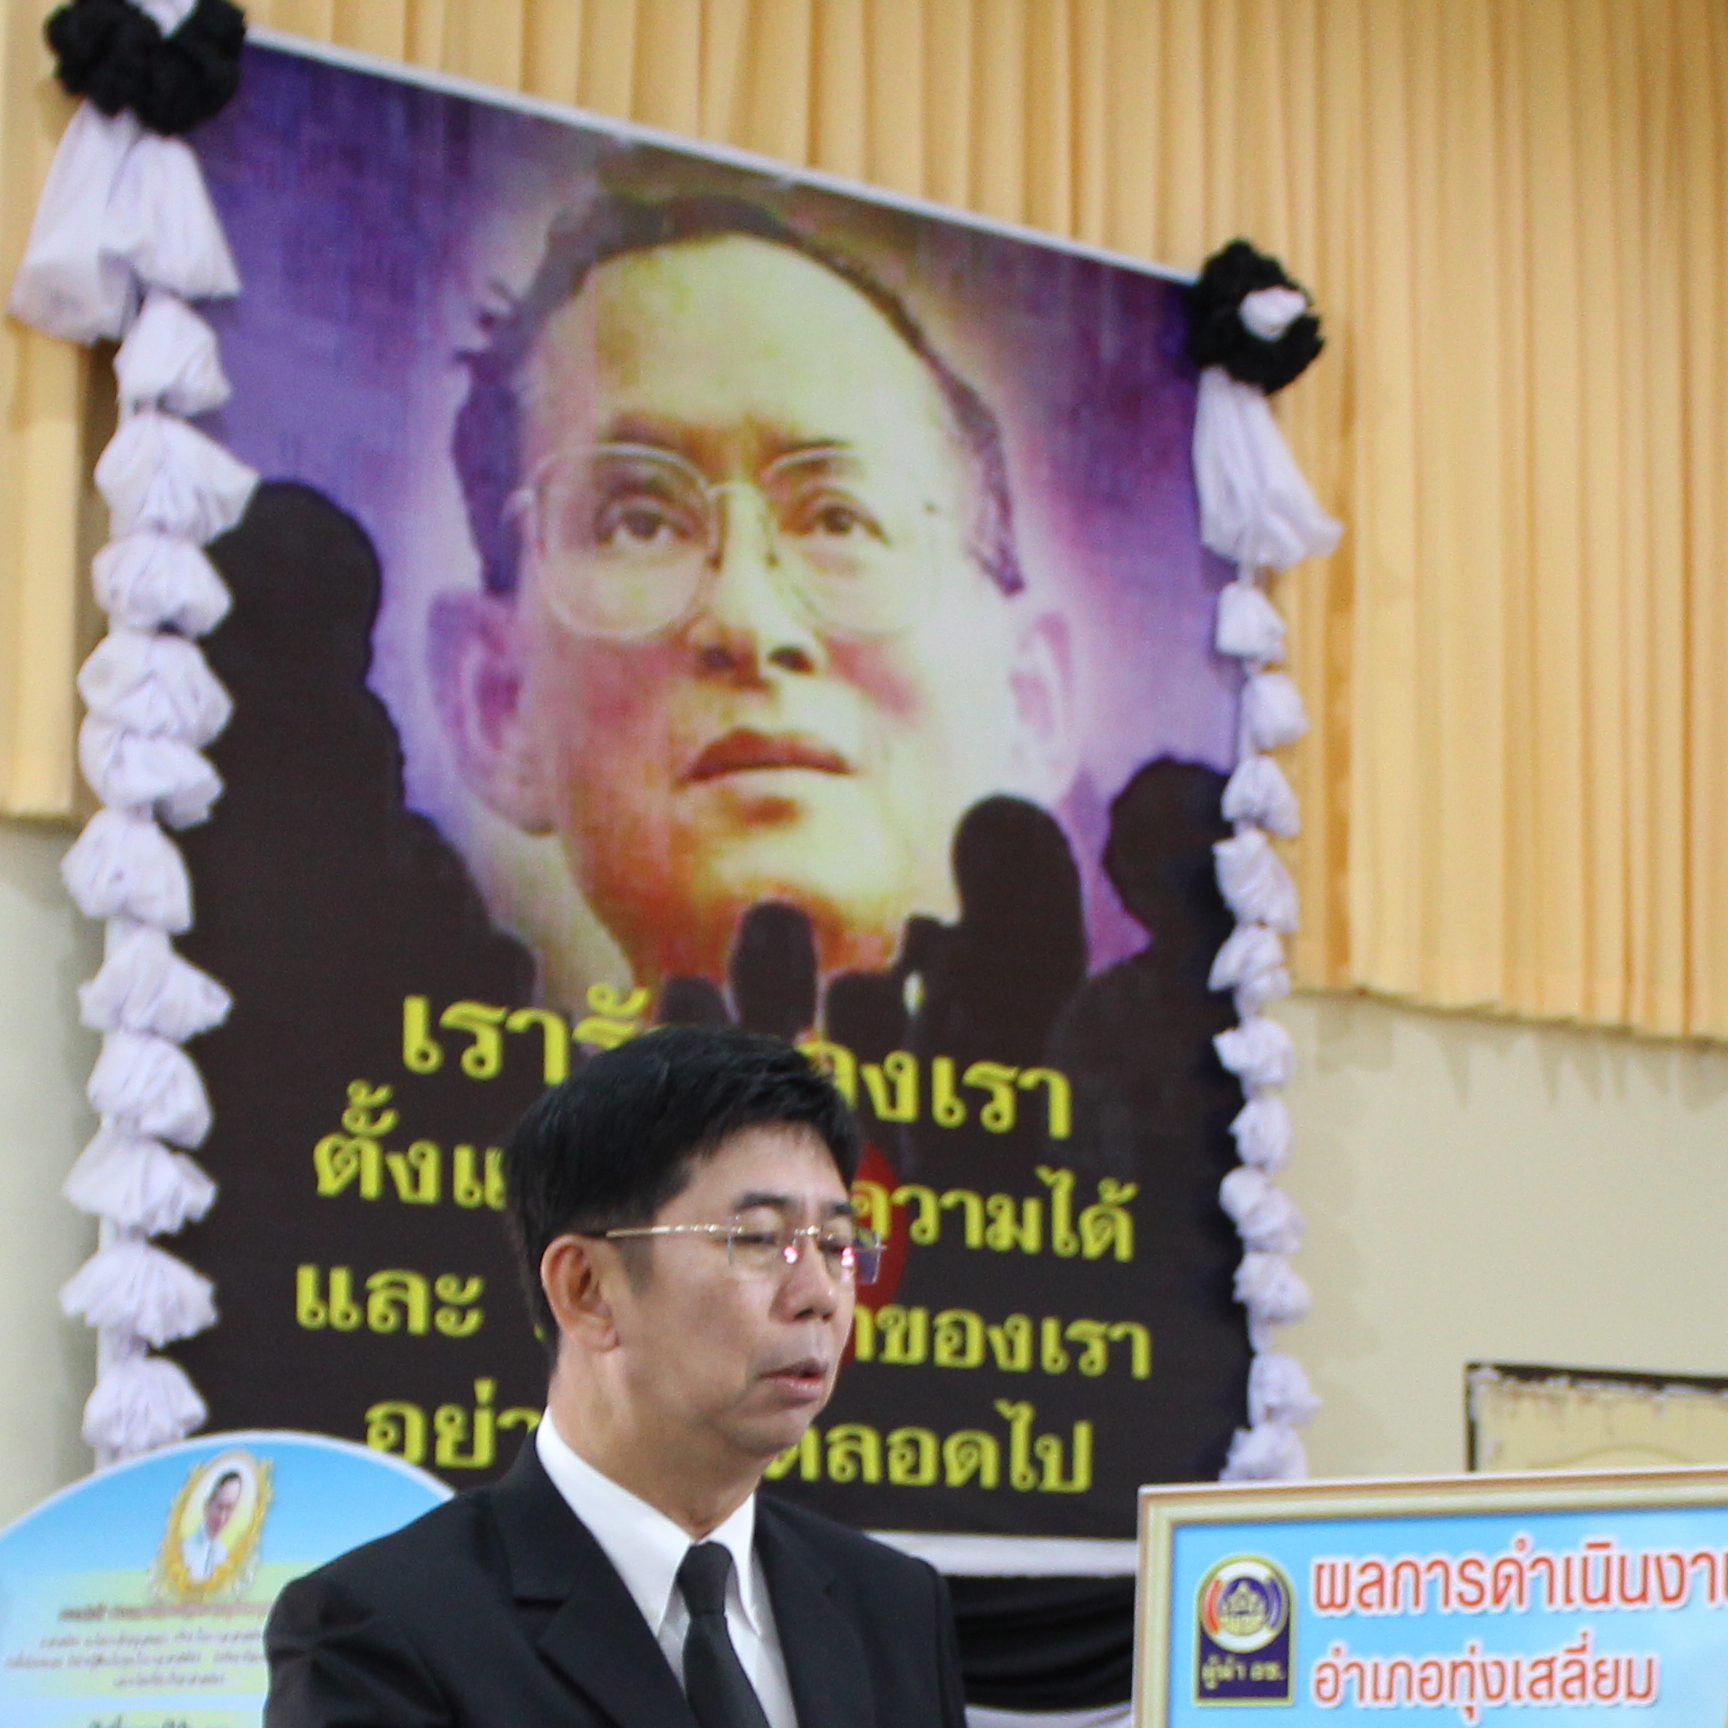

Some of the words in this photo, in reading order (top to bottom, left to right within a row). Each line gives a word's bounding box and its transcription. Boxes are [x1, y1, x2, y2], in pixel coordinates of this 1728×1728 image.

[296, 1263, 485, 1338] และ
[1312, 1630, 1658, 1724] อำเภอทุ่งเสลี่ยม
